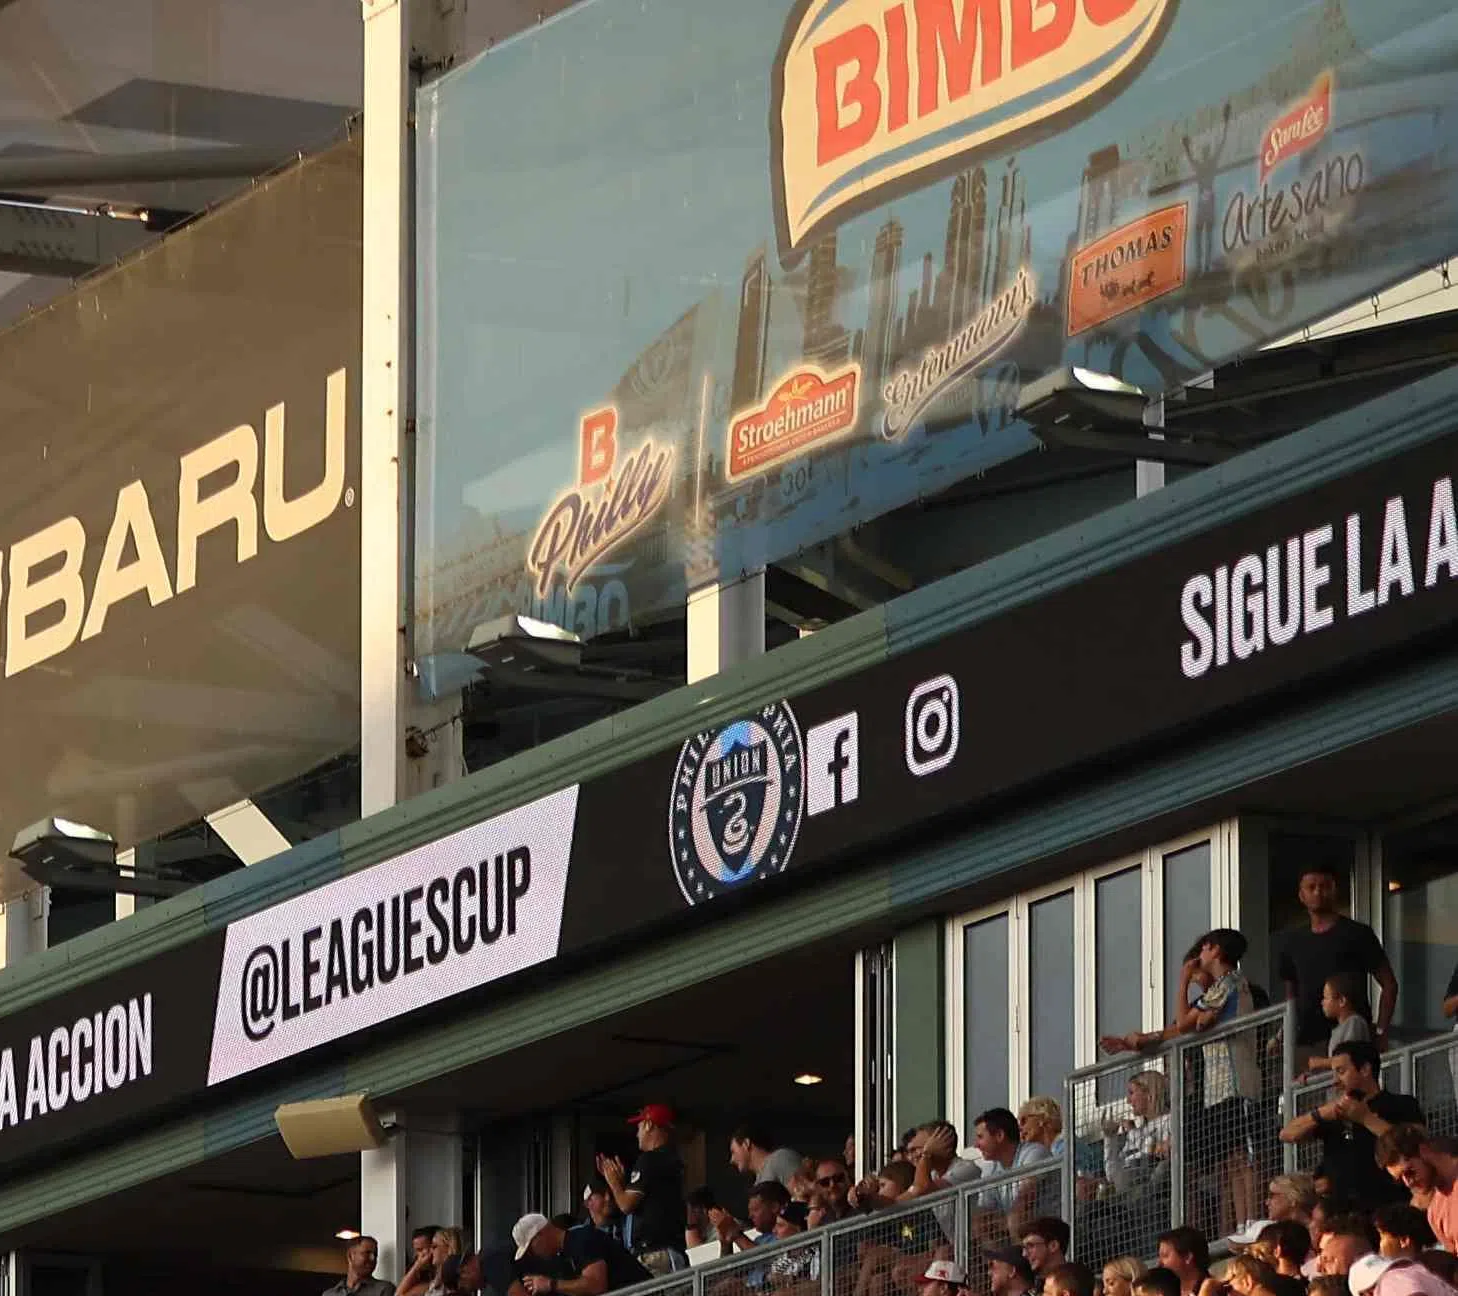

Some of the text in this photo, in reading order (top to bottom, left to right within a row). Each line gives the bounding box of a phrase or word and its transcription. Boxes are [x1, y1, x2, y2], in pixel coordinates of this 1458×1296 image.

[813, 0, 1139, 168] BIMB
[738, 387, 846, 453] Stroehmann
[531, 442, 674, 595] Philly
[1180, 524, 1334, 679] SIGUE
[1347, 495, 1415, 616] LA
[710, 749, 762, 788] UNION
[240, 845, 533, 1042] @LEAGUESCUP
[24, 992, 152, 1121] ACCION
